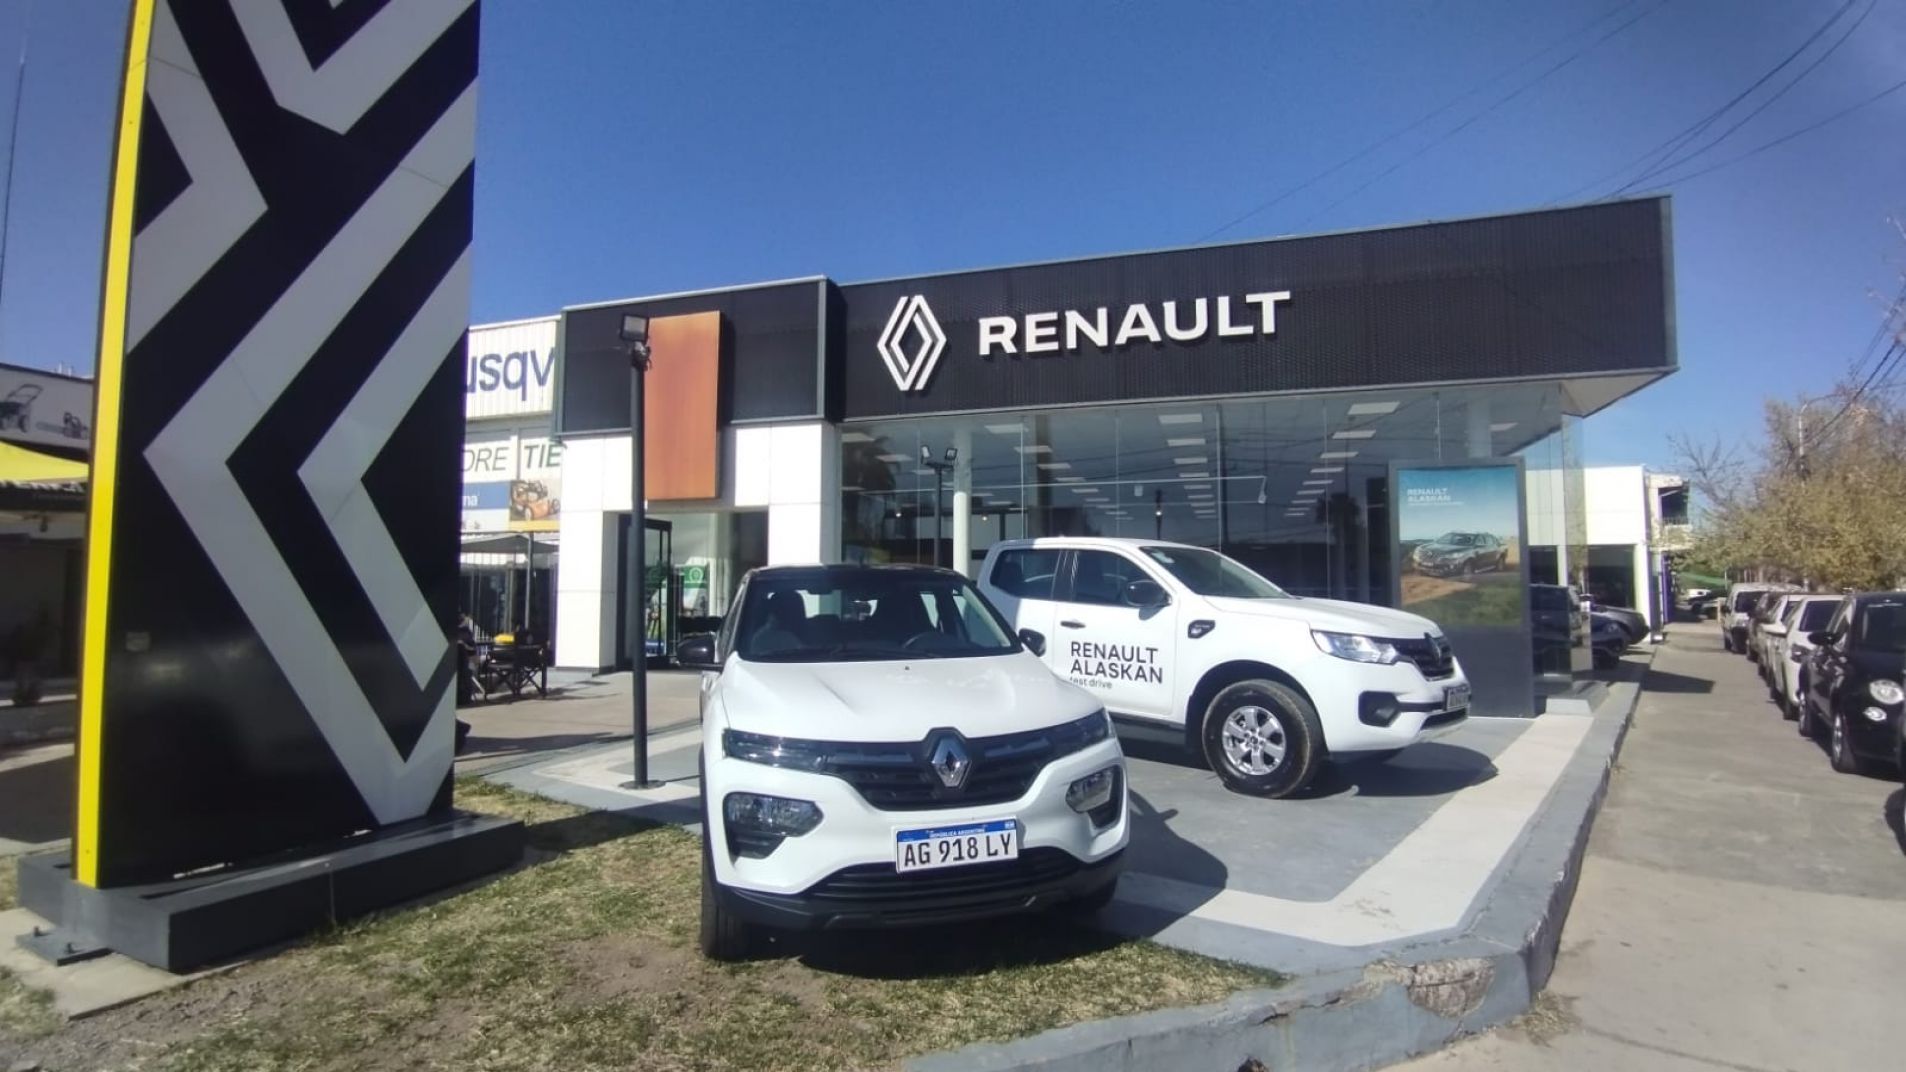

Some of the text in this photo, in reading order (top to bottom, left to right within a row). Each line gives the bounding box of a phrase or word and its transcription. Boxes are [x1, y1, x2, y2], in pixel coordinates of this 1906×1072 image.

[978, 291, 1291, 356] RENAULT
[1407, 487, 1448, 496] RENAULT
[1070, 641, 1159, 664] RENAULT
[1070, 659, 1163, 684] ALASKAN
[1088, 679, 1113, 690] drive
[904, 833, 1011, 868] AG 918 LY
